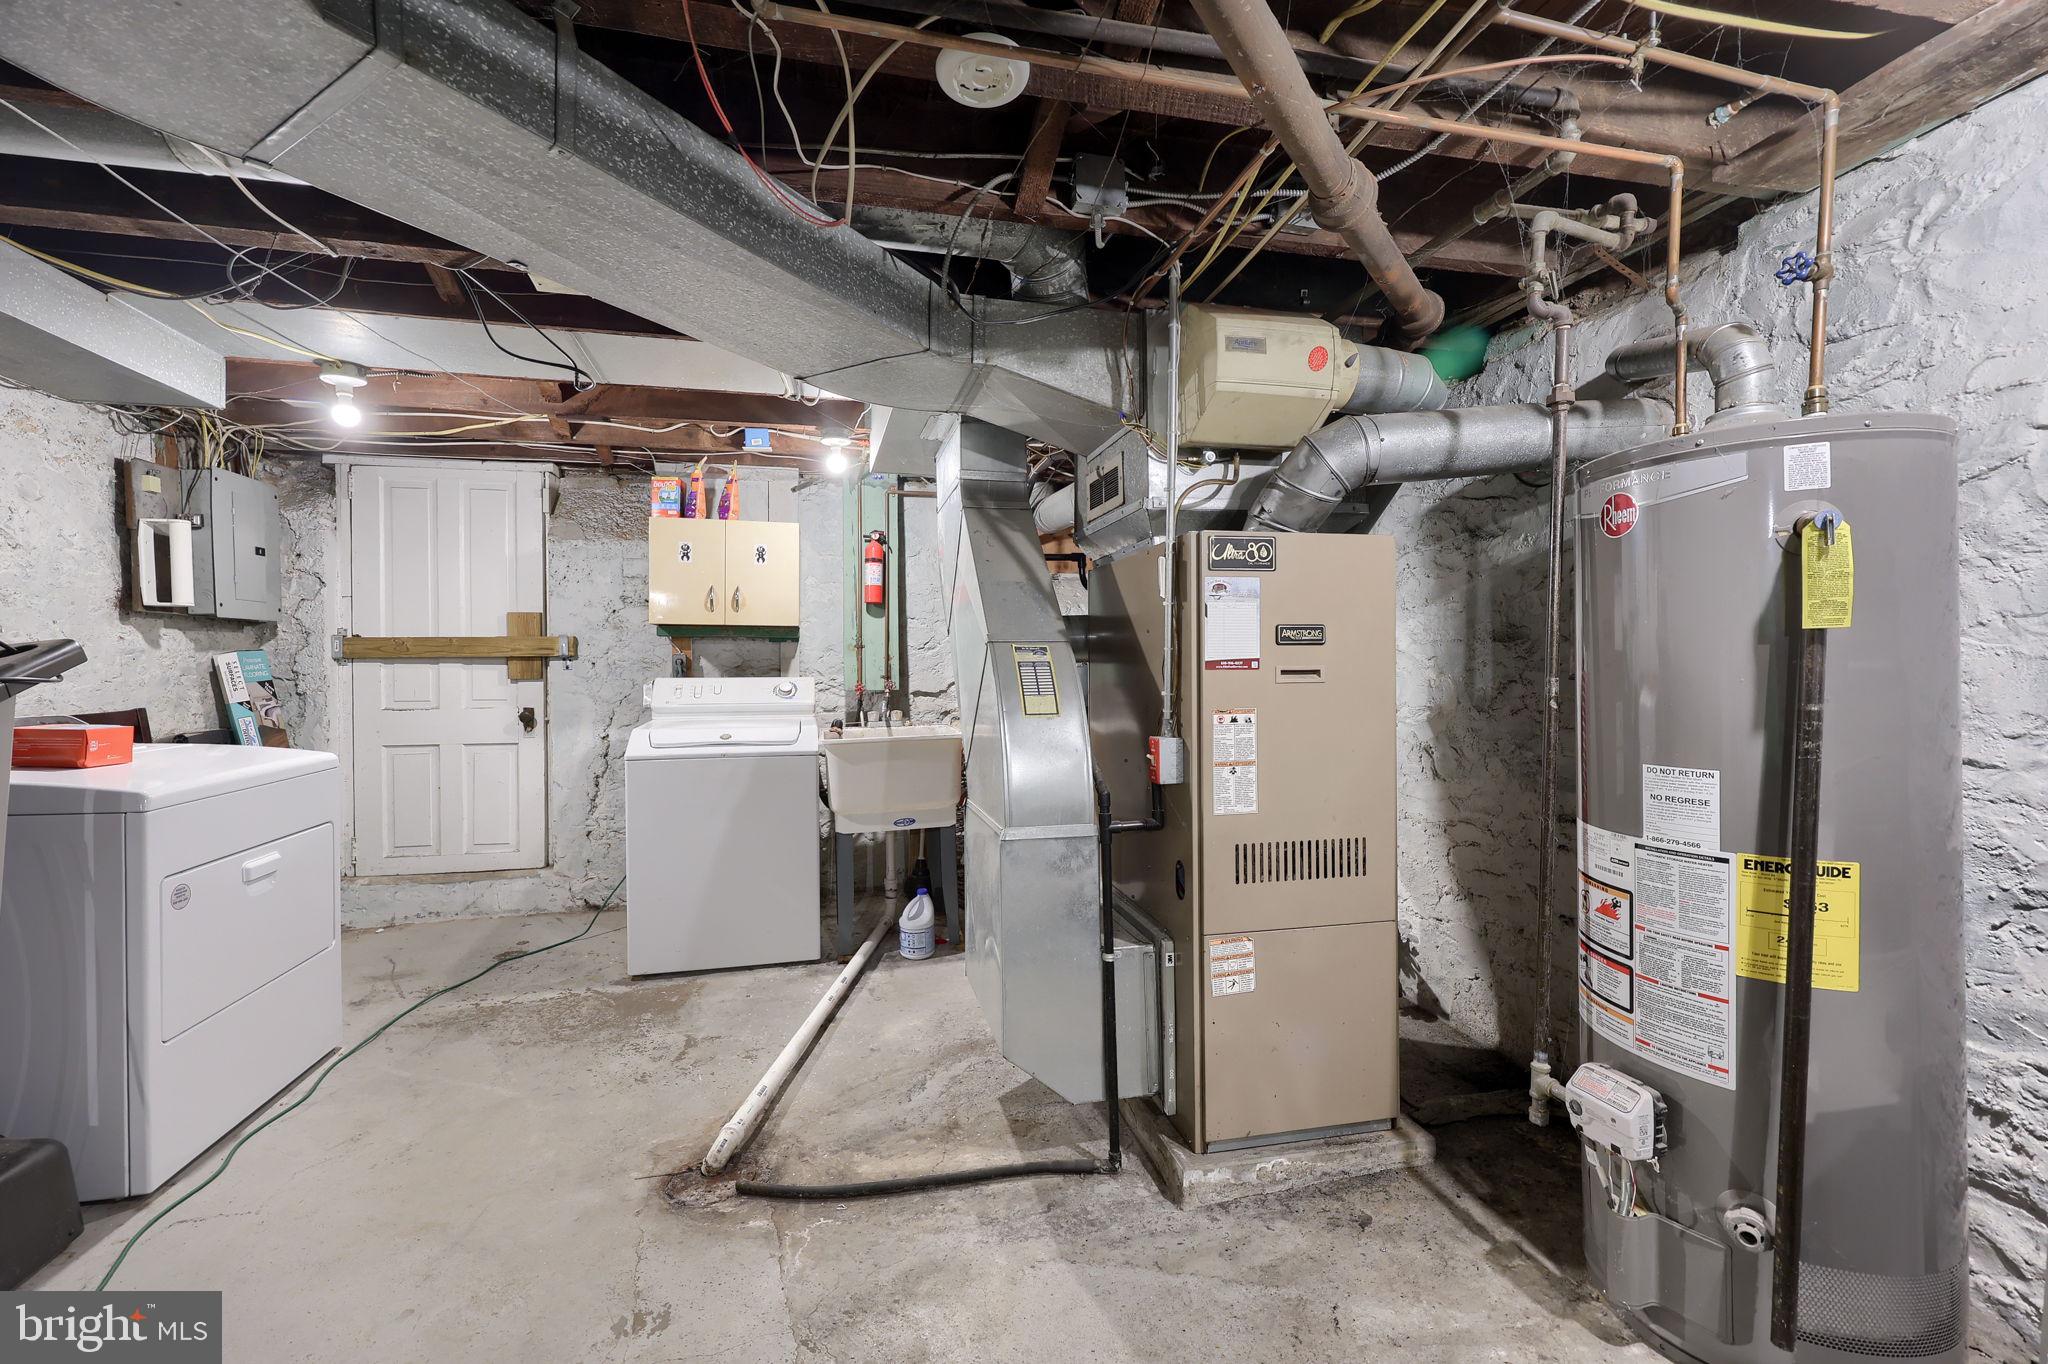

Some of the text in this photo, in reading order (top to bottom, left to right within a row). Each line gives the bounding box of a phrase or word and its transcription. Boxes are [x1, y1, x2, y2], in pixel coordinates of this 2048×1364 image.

[1604, 496, 1636, 531] Rheem
[1282, 629, 1323, 638] ARMSTRONG
[225, 662, 239, 692] SURFACES
[232, 661, 245, 690] SELECT
[1646, 766, 1715, 779] DO NOT RETURN
[1650, 793, 1711, 807] NO REGRESE
[1646, 835, 1702, 849] 1-866-279-4566
